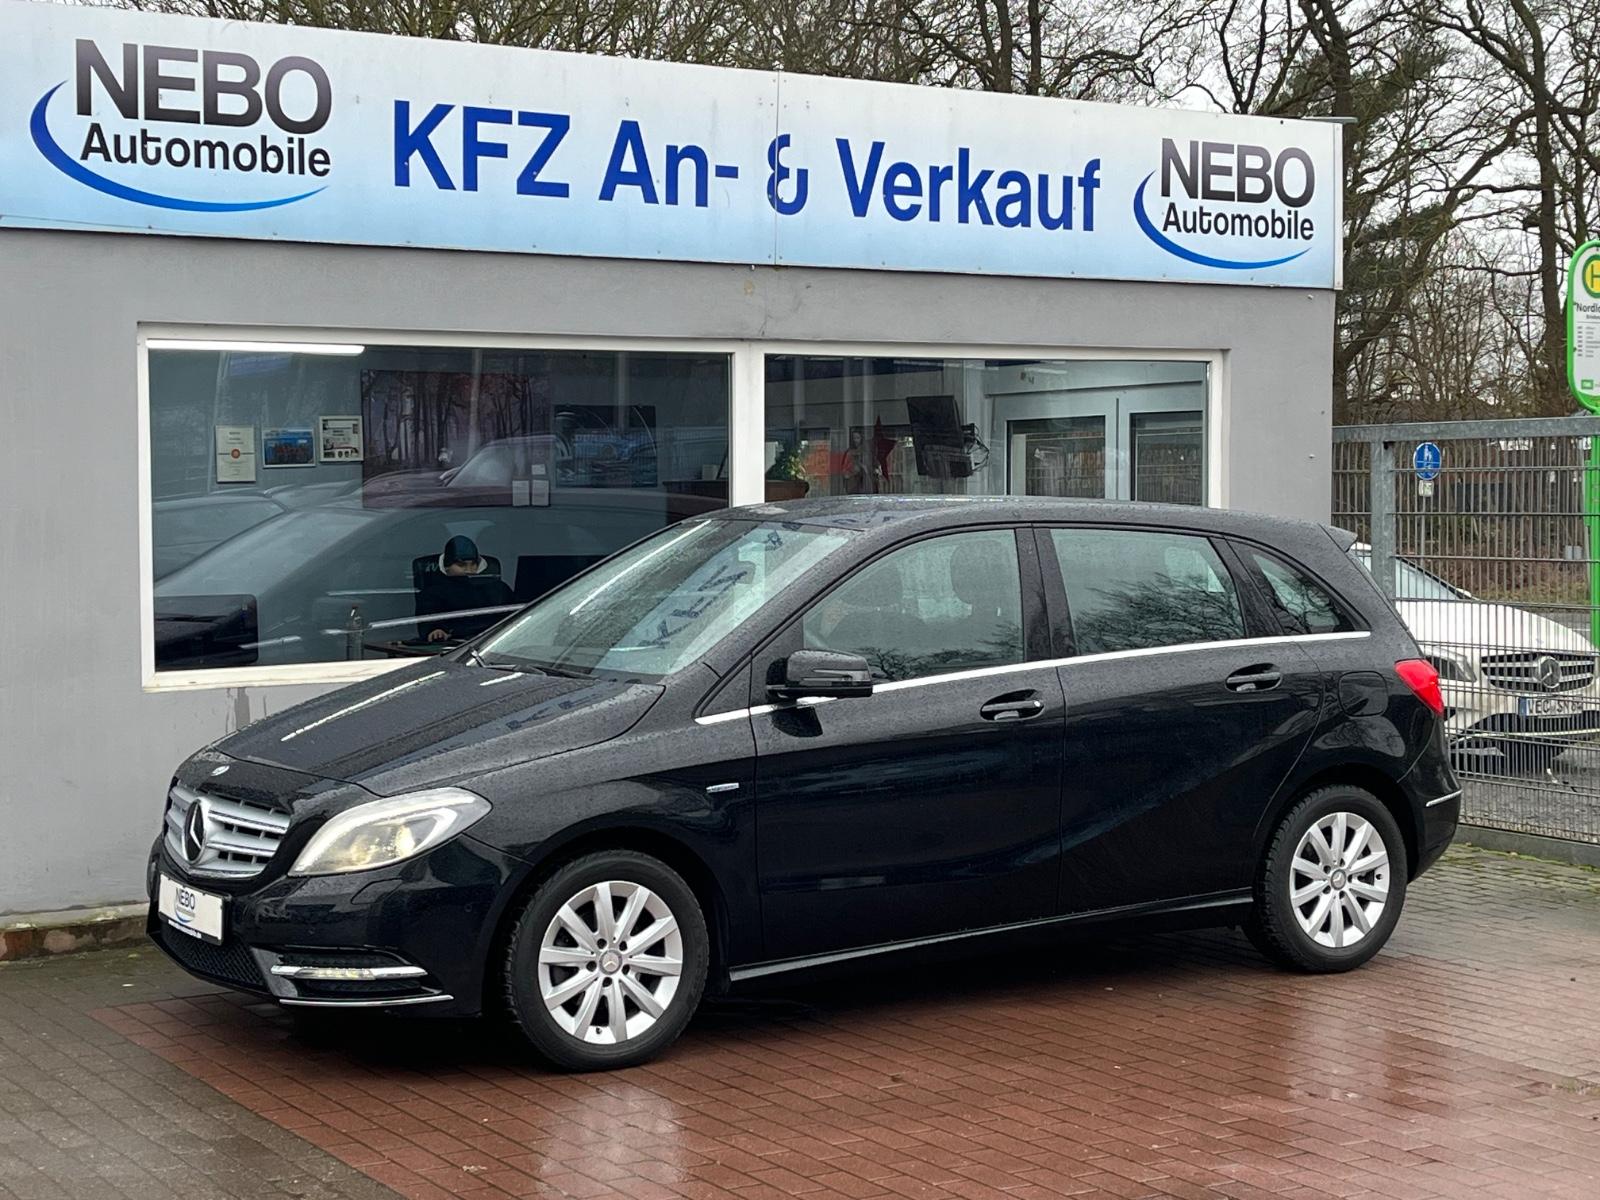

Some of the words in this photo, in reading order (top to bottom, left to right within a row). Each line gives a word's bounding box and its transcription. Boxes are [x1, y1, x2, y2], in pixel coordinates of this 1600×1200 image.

[75, 39, 332, 134] NEBO
[80, 122, 332, 177] Automobile
[393, 100, 571, 198] KFZ
[598, 119, 739, 209] An-
[767, 133, 809, 216] &
[835, 137, 1102, 232] Verkauf
[1160, 137, 1315, 208] NEBO
[1161, 202, 1315, 241] Automobile
